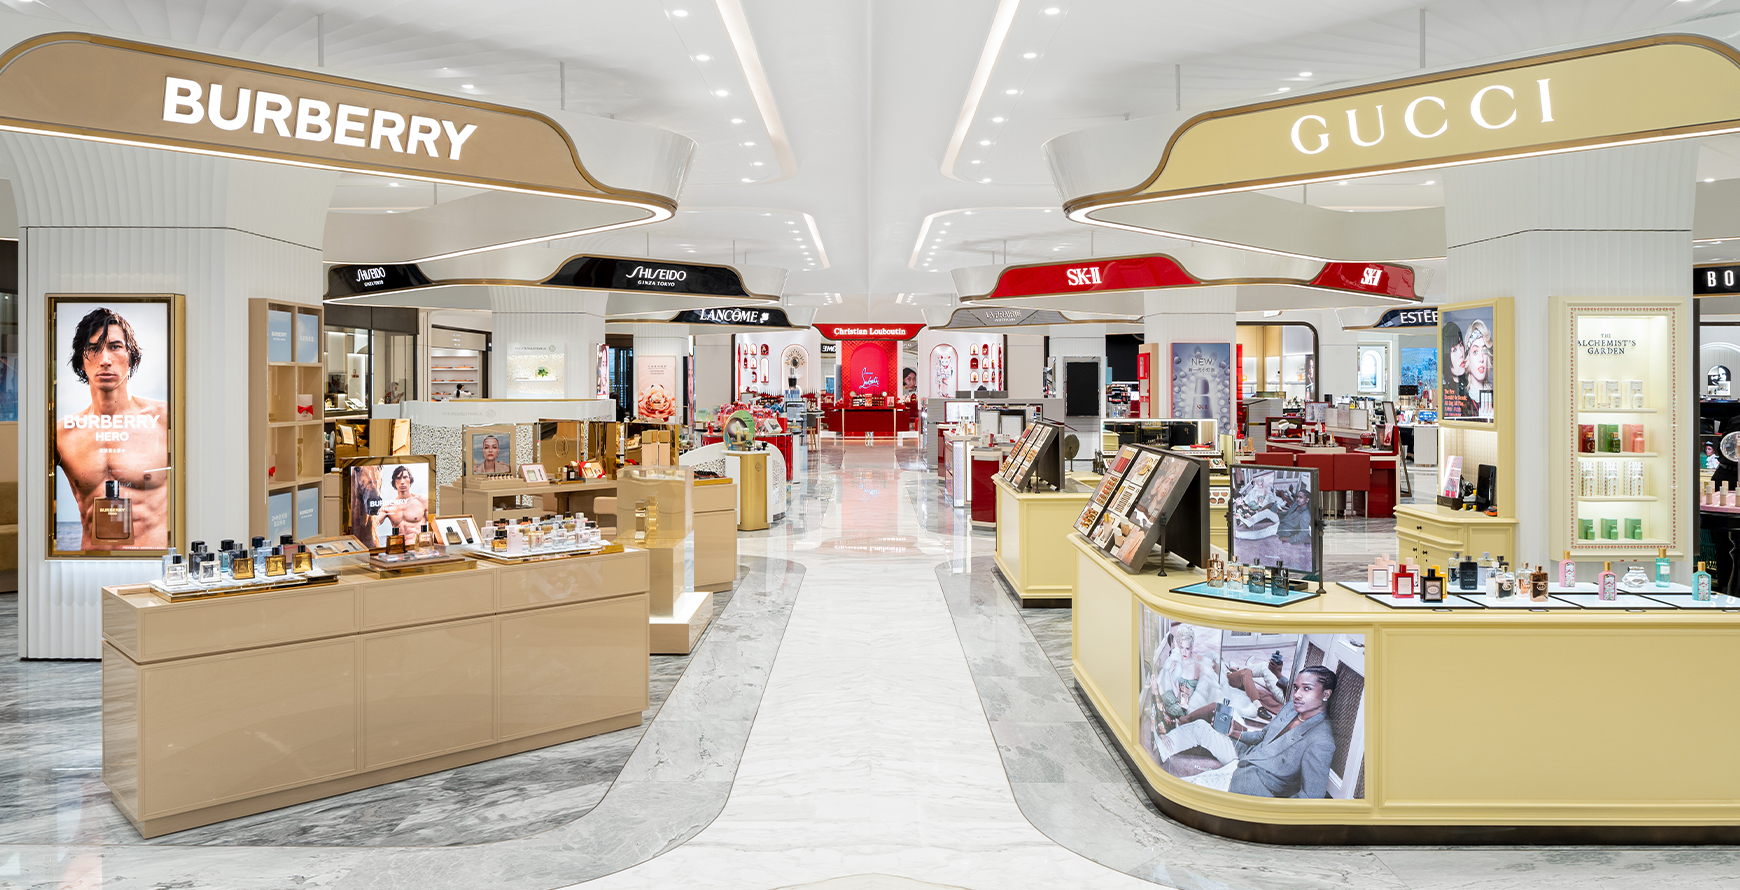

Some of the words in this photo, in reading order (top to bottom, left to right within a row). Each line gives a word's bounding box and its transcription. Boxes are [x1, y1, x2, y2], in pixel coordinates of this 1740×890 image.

[162, 76, 478, 161] BURBERRY
[1290, 78, 1555, 155] GUCCI
[356, 267, 386, 282] SHISEIDO
[626, 266, 687, 281] SHISEIDO
[1066, 266, 1102, 286] SK-II
[700, 308, 759, 323] LANCÔME
[834, 327, 868, 335] Christian
[869, 327, 906, 335] Louboutin
[1588, 347, 1625, 355] GARDEN
[1191, 358, 1213, 366] NEW
[63, 414, 160, 429] BURBERRY
[95, 431, 130, 442] HERO
